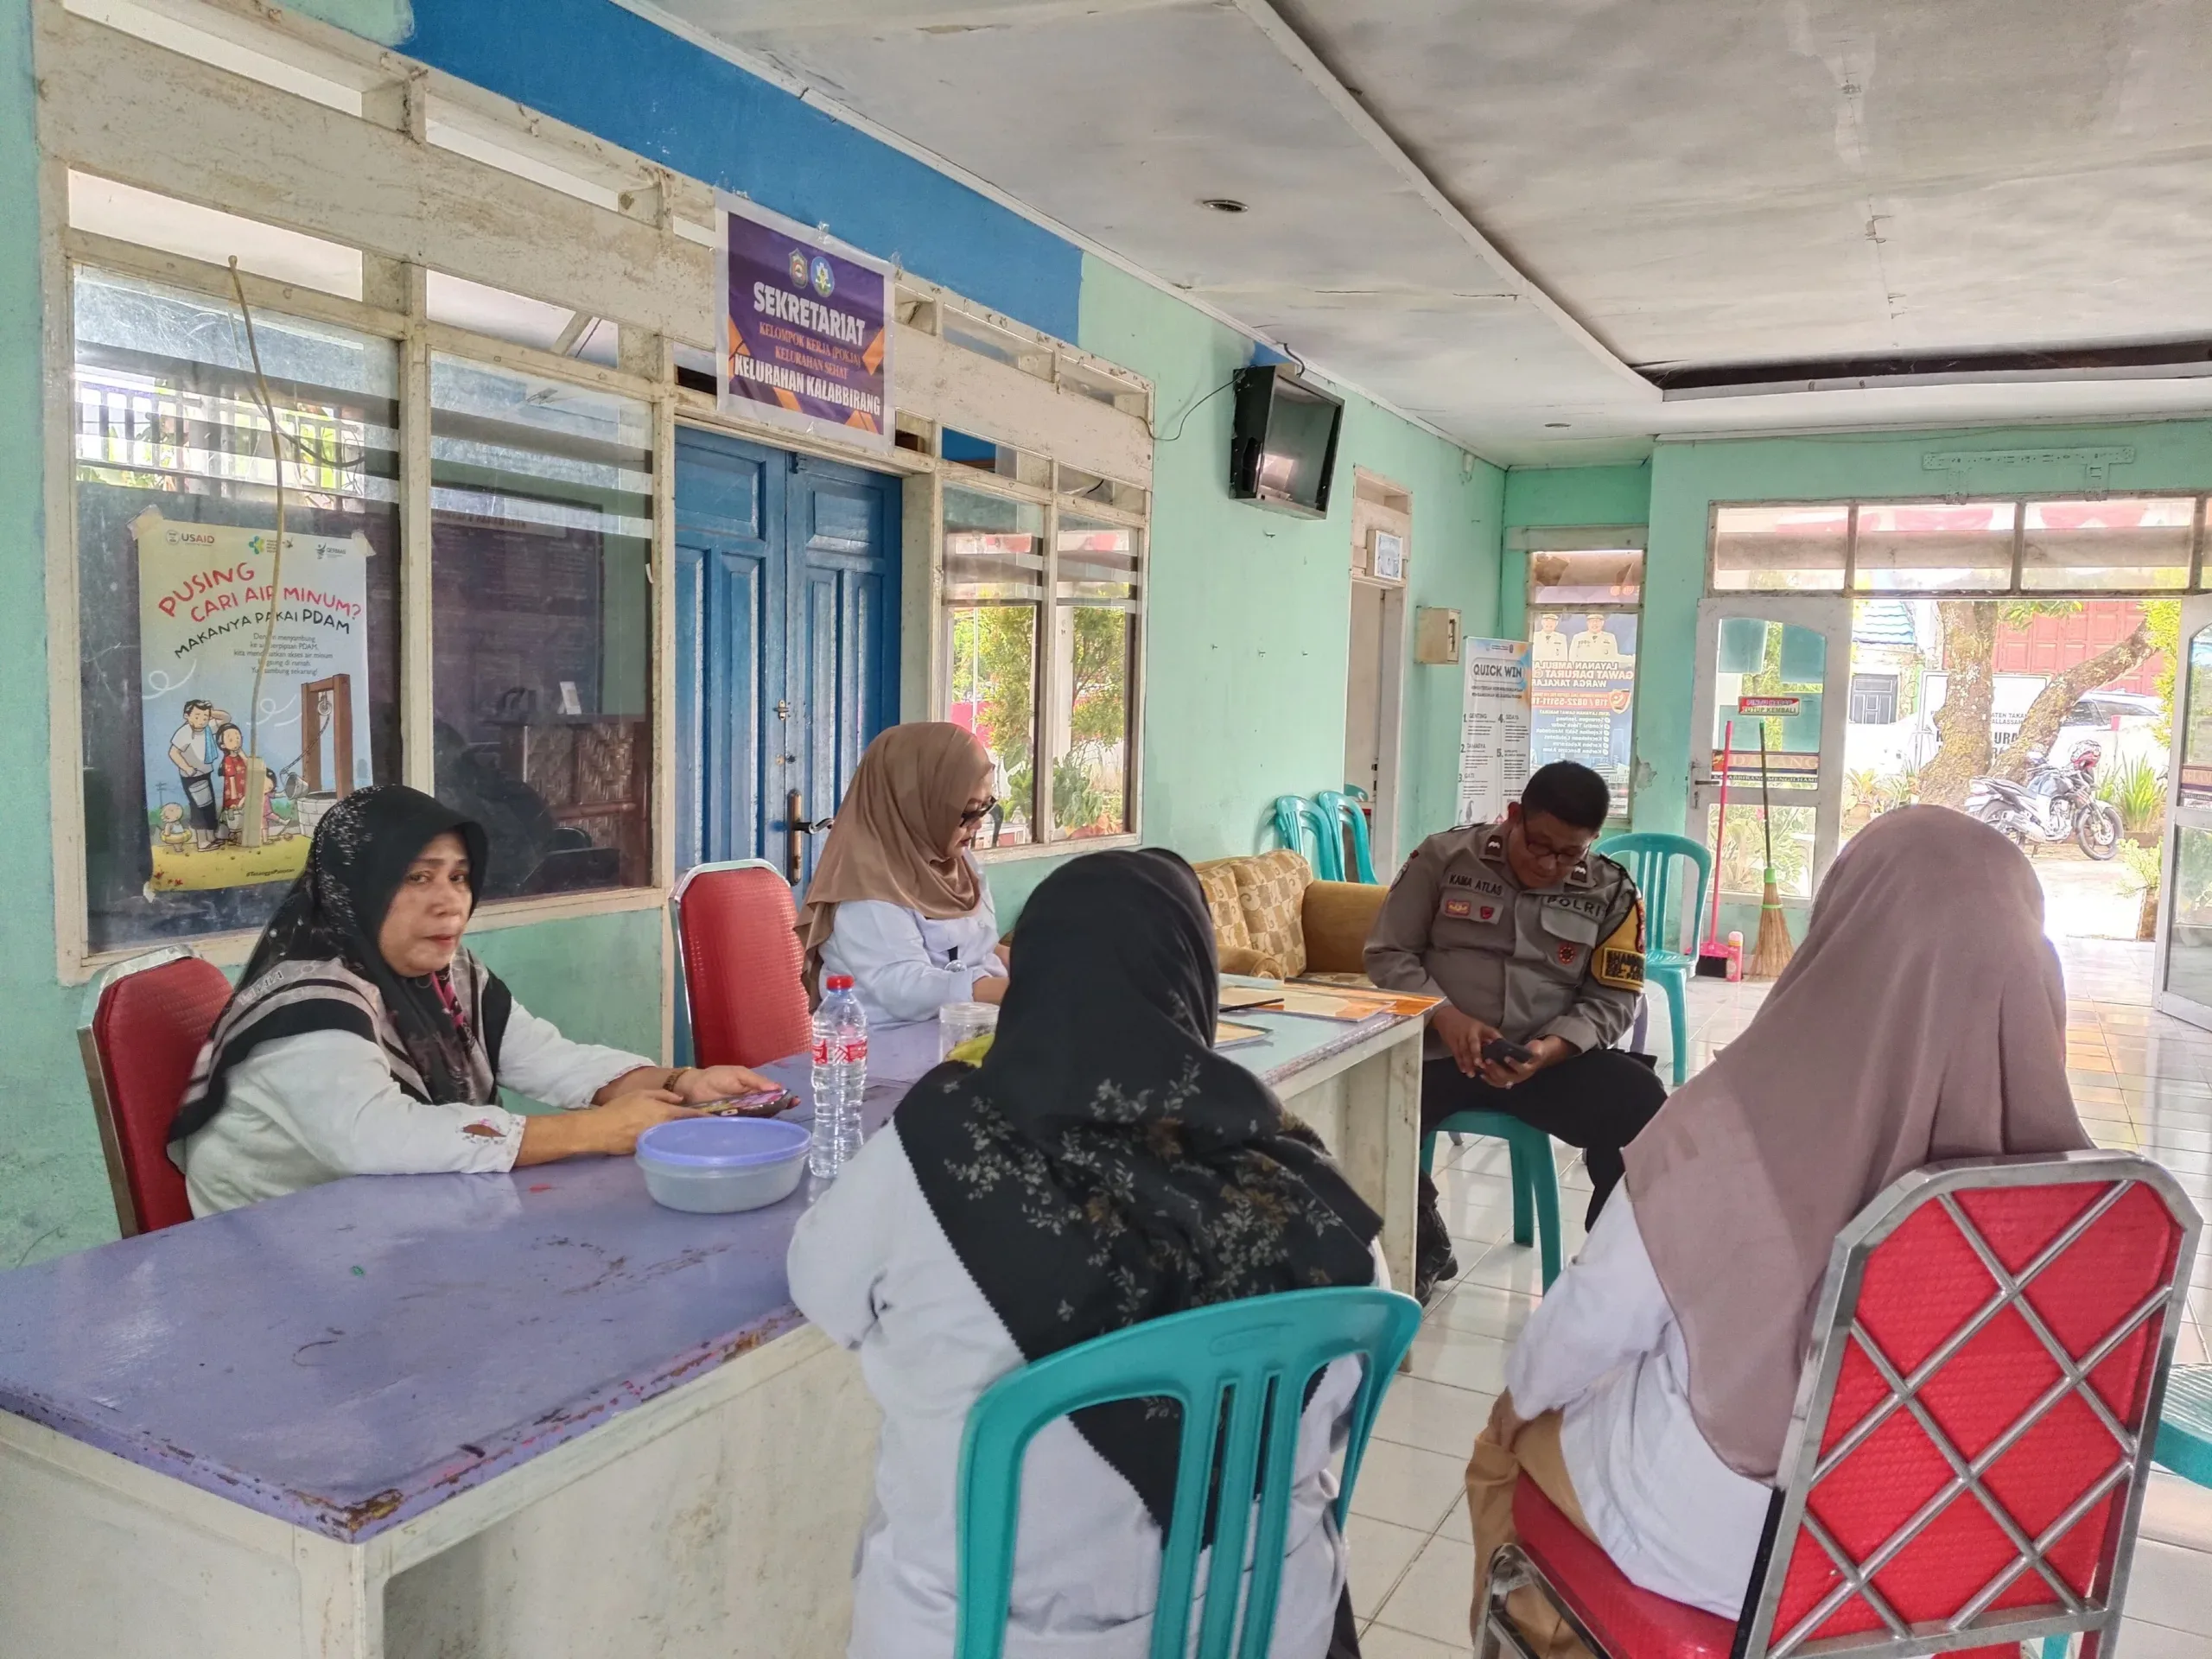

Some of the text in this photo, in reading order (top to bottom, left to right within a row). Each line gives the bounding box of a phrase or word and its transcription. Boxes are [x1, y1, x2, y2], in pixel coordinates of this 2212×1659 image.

[753, 281, 866, 346] SEKRETARIAT
[760, 321, 804, 347] KELOMPOK
[806, 336, 831, 357] KERJA
[775, 346, 849, 380] KELURAHAN SEHAT
[734, 353, 880, 416] KELURAHAN KALABBIRANG
[181, 532, 215, 544] USAID
[158, 562, 255, 618] PUSING
[190, 592, 238, 622] CARI
[283, 587, 362, 620] MINUM?
[175, 612, 252, 659] MAKANYA
[303, 608, 350, 634] PDAM
[1473, 664, 1522, 678] QUICK WIN
[1497, 747, 1504, 758] 5.
[1475, 880, 1503, 896] ATLAS
[1547, 897, 1601, 917] POLRI
